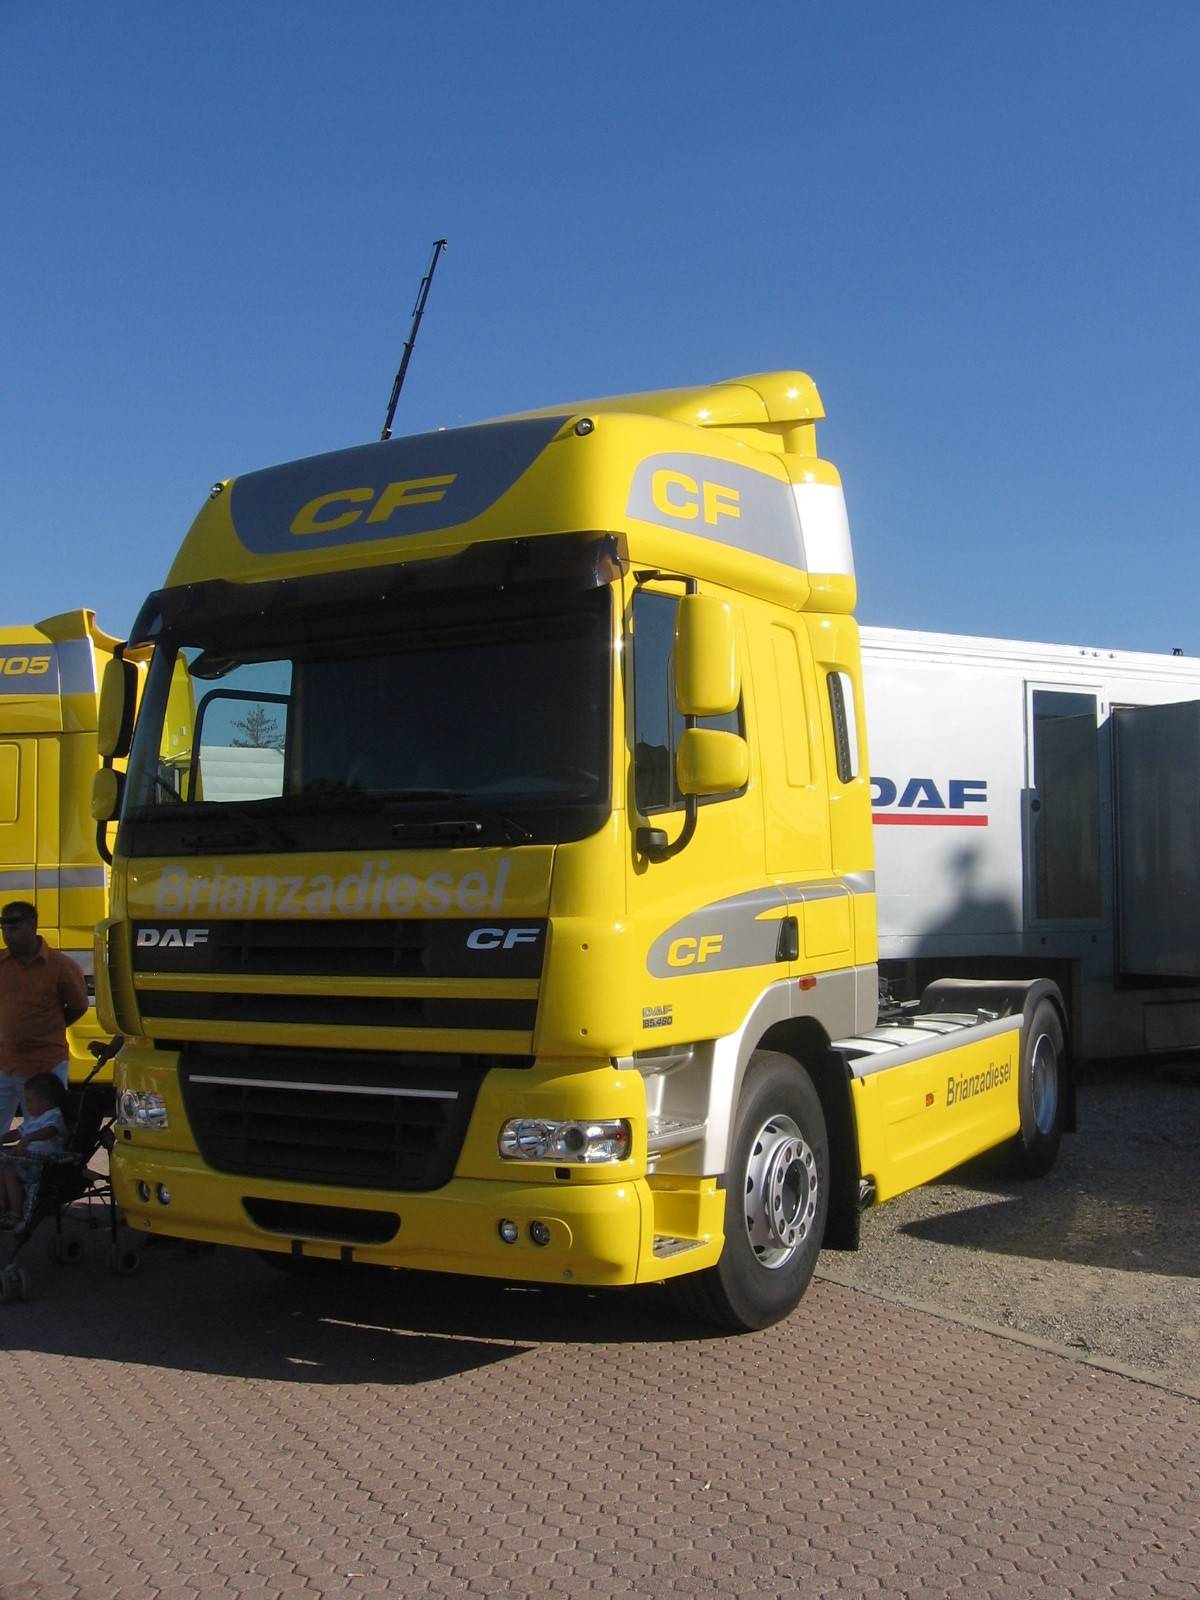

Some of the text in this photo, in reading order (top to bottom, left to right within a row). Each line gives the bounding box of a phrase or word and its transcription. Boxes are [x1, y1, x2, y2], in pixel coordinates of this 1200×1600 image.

[288, 473, 457, 535] CF
[651, 469, 741, 526] CF
[154, 857, 511, 914] Brianzadiesel
[136, 928, 209, 947] DAF
[466, 928, 541, 950] CF
[667, 934, 724, 967] CF
[642, 1004, 673, 1017] DAF
[946, 1055, 1012, 1107] Brianzadiesel
